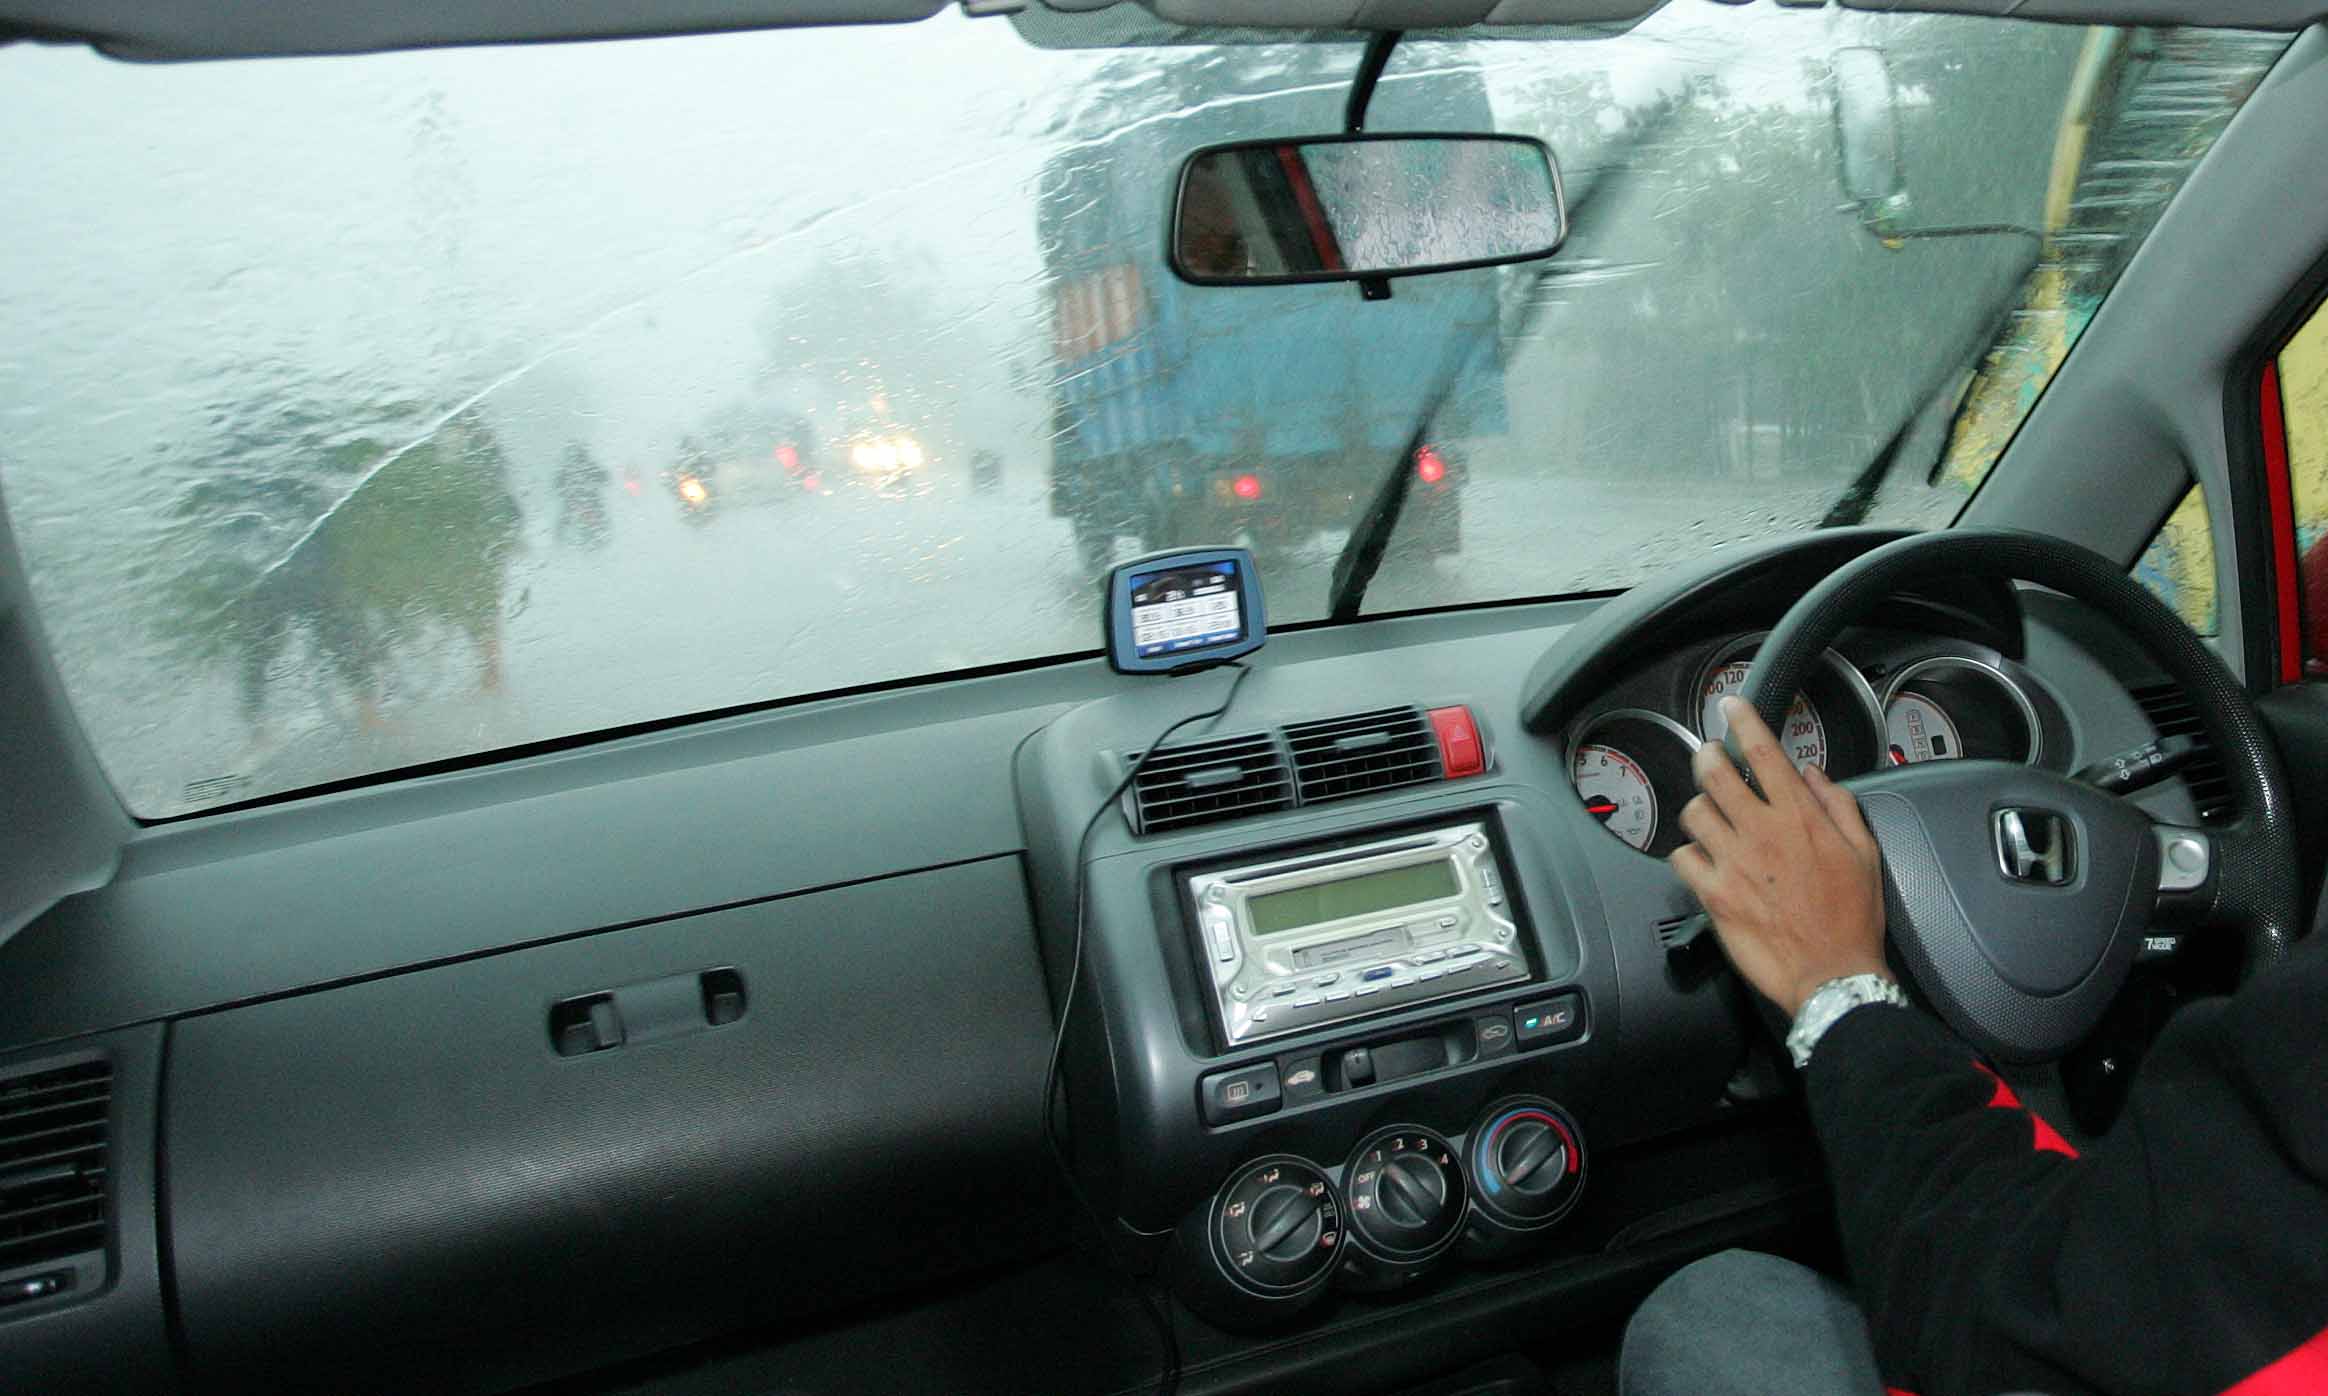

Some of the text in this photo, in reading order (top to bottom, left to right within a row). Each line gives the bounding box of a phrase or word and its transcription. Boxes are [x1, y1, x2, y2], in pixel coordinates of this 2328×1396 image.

[1724, 670, 1744, 684] 120
[1703, 681, 1724, 697] 100
[1792, 721, 1814, 737] 200
[1796, 744, 1818, 759] 220
[1601, 756, 1608, 767] 6
[1620, 764, 1626, 777] 7
[2145, 937, 2153, 950] 7
[1543, 1011, 1565, 1026] A/C
[1394, 1138, 1405, 1150] 2
[1418, 1138, 1428, 1150] 3
[1440, 1153, 1449, 1165] 4
[1359, 1171, 1376, 1183] OFF
